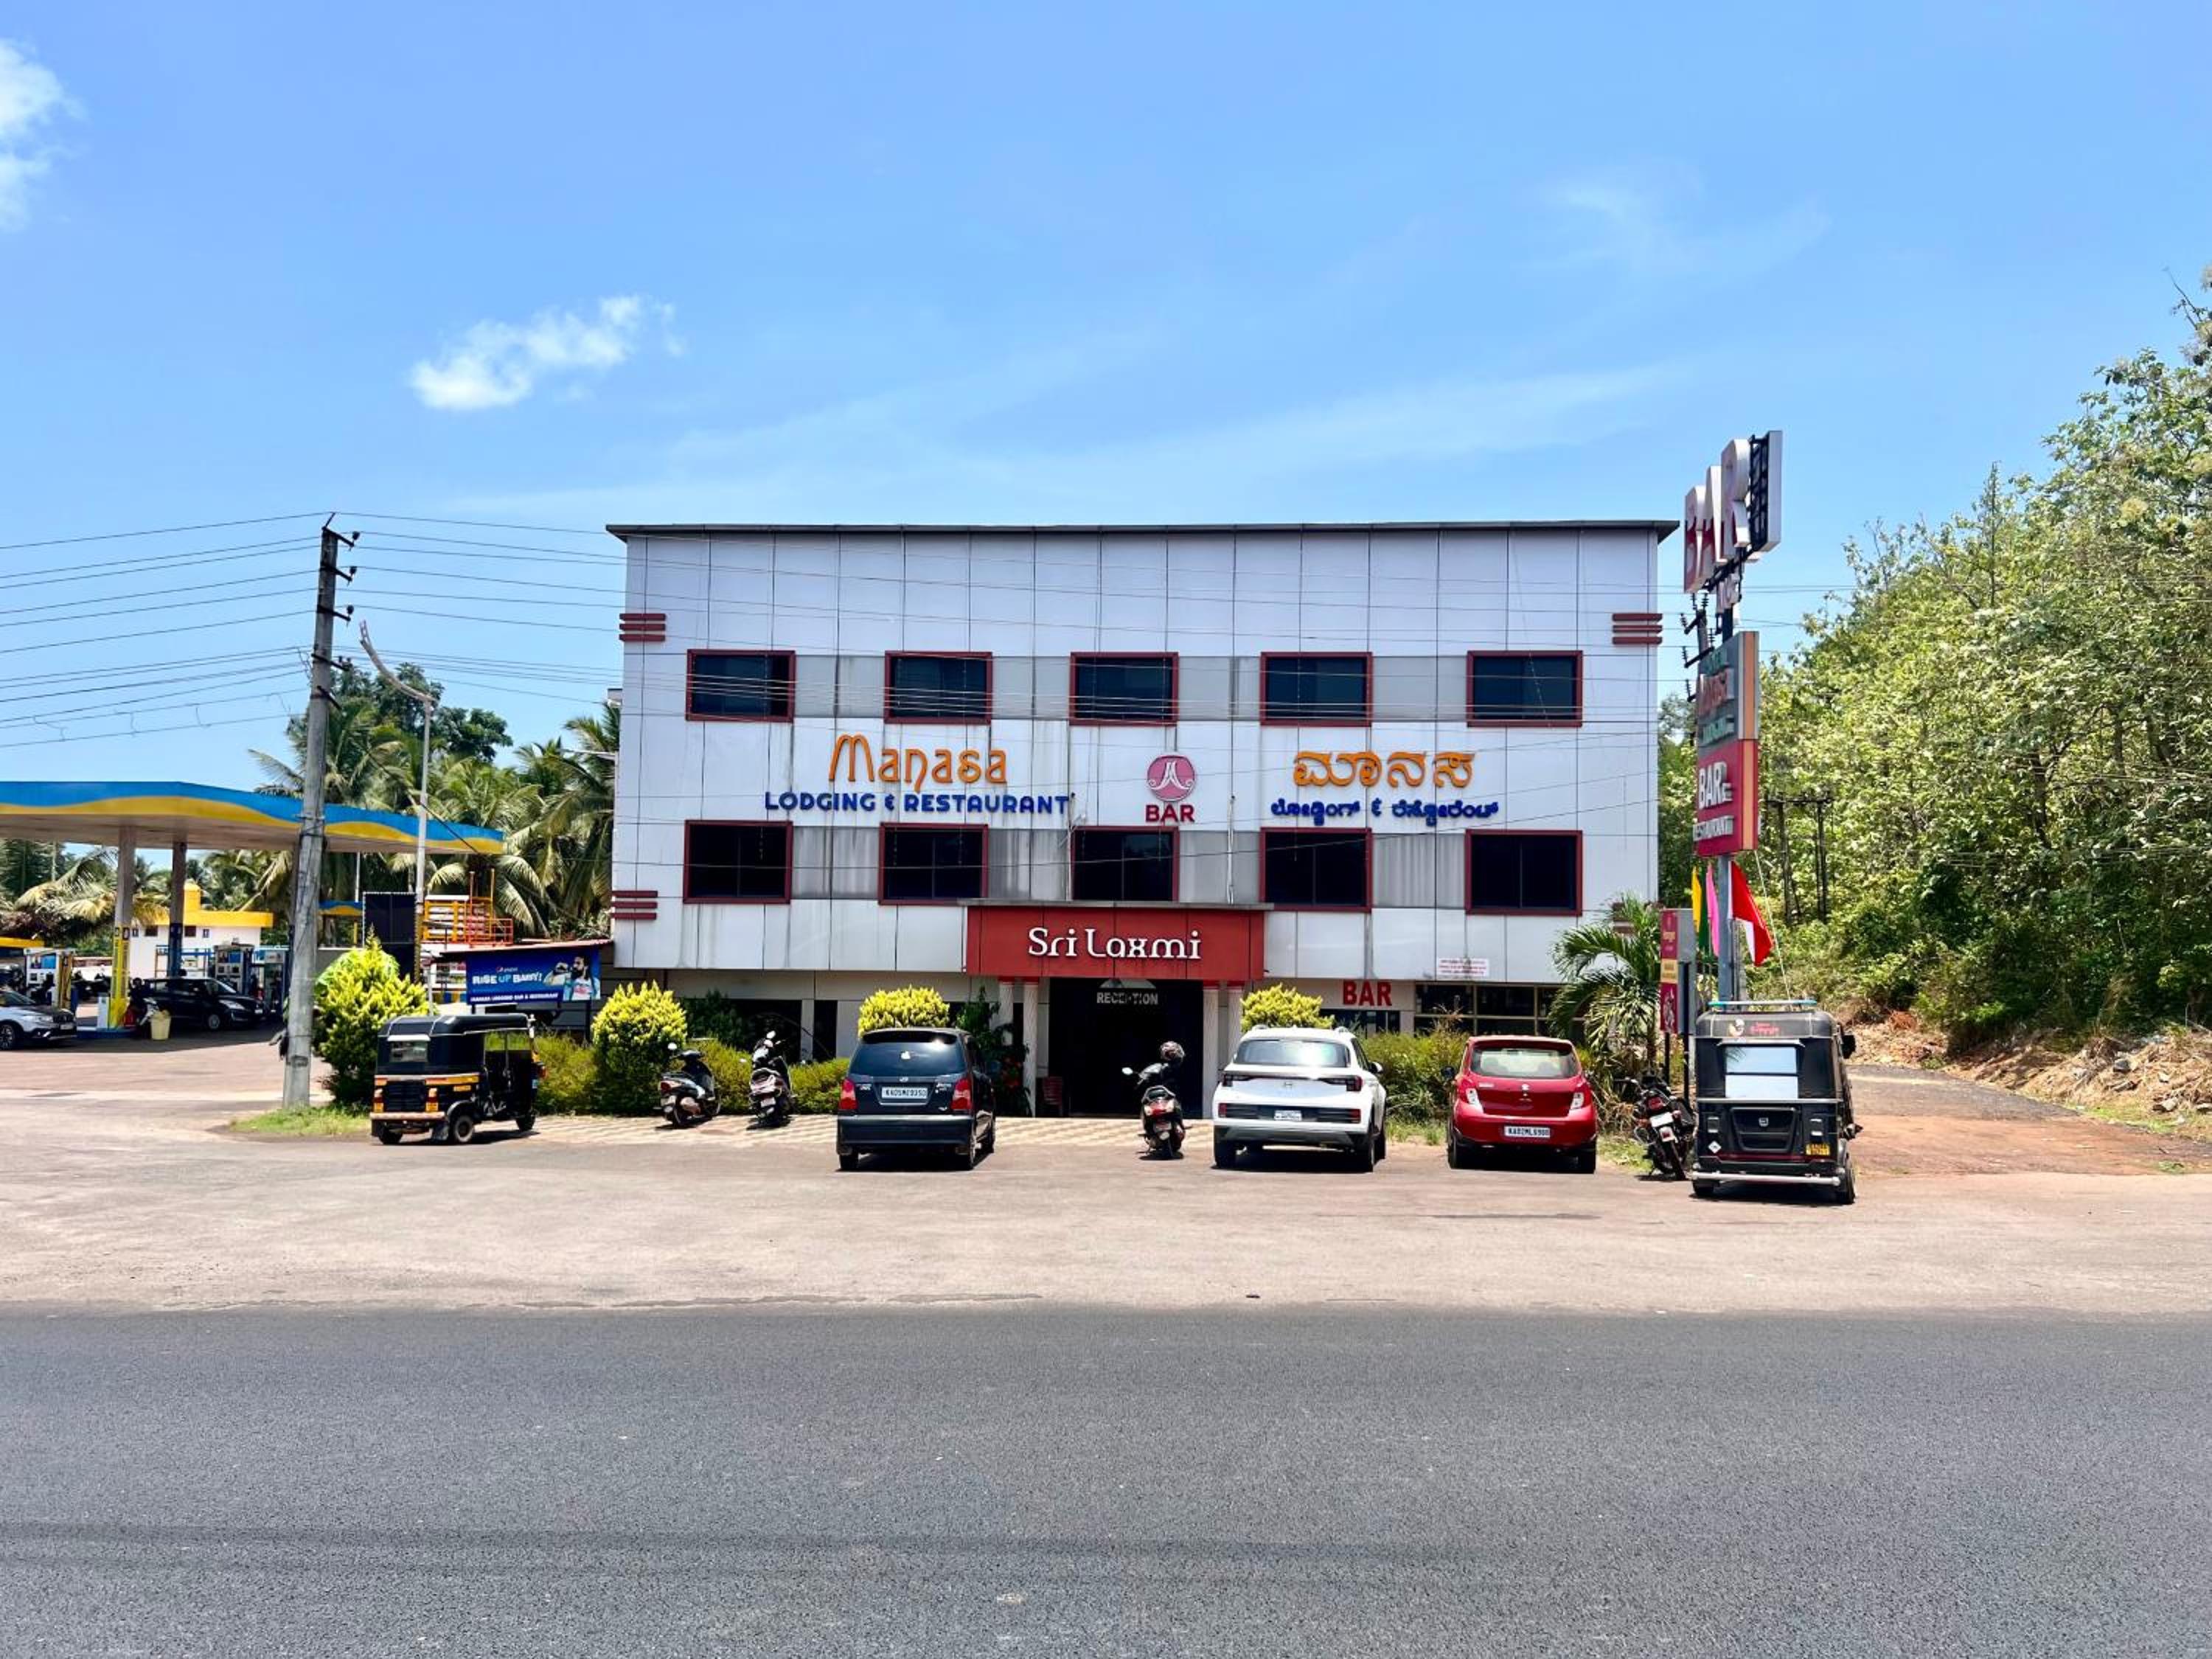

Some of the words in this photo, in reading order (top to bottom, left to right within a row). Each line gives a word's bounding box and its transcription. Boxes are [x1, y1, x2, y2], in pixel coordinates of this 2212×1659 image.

[829, 734, 1007, 792] Manasa
[1293, 751, 1475, 787] ಮಾನಸ
[1699, 761, 1727, 810] BAR
[765, 791, 876, 812] LODGING
[904, 793, 1070, 814] RESTAURANT
[1145, 803, 1195, 823] BAR
[1029, 927, 1077, 956] Sri
[1085, 928, 1201, 959] Laxmi
[498, 973, 512, 983] UP
[1343, 979, 1392, 1006] BAR
